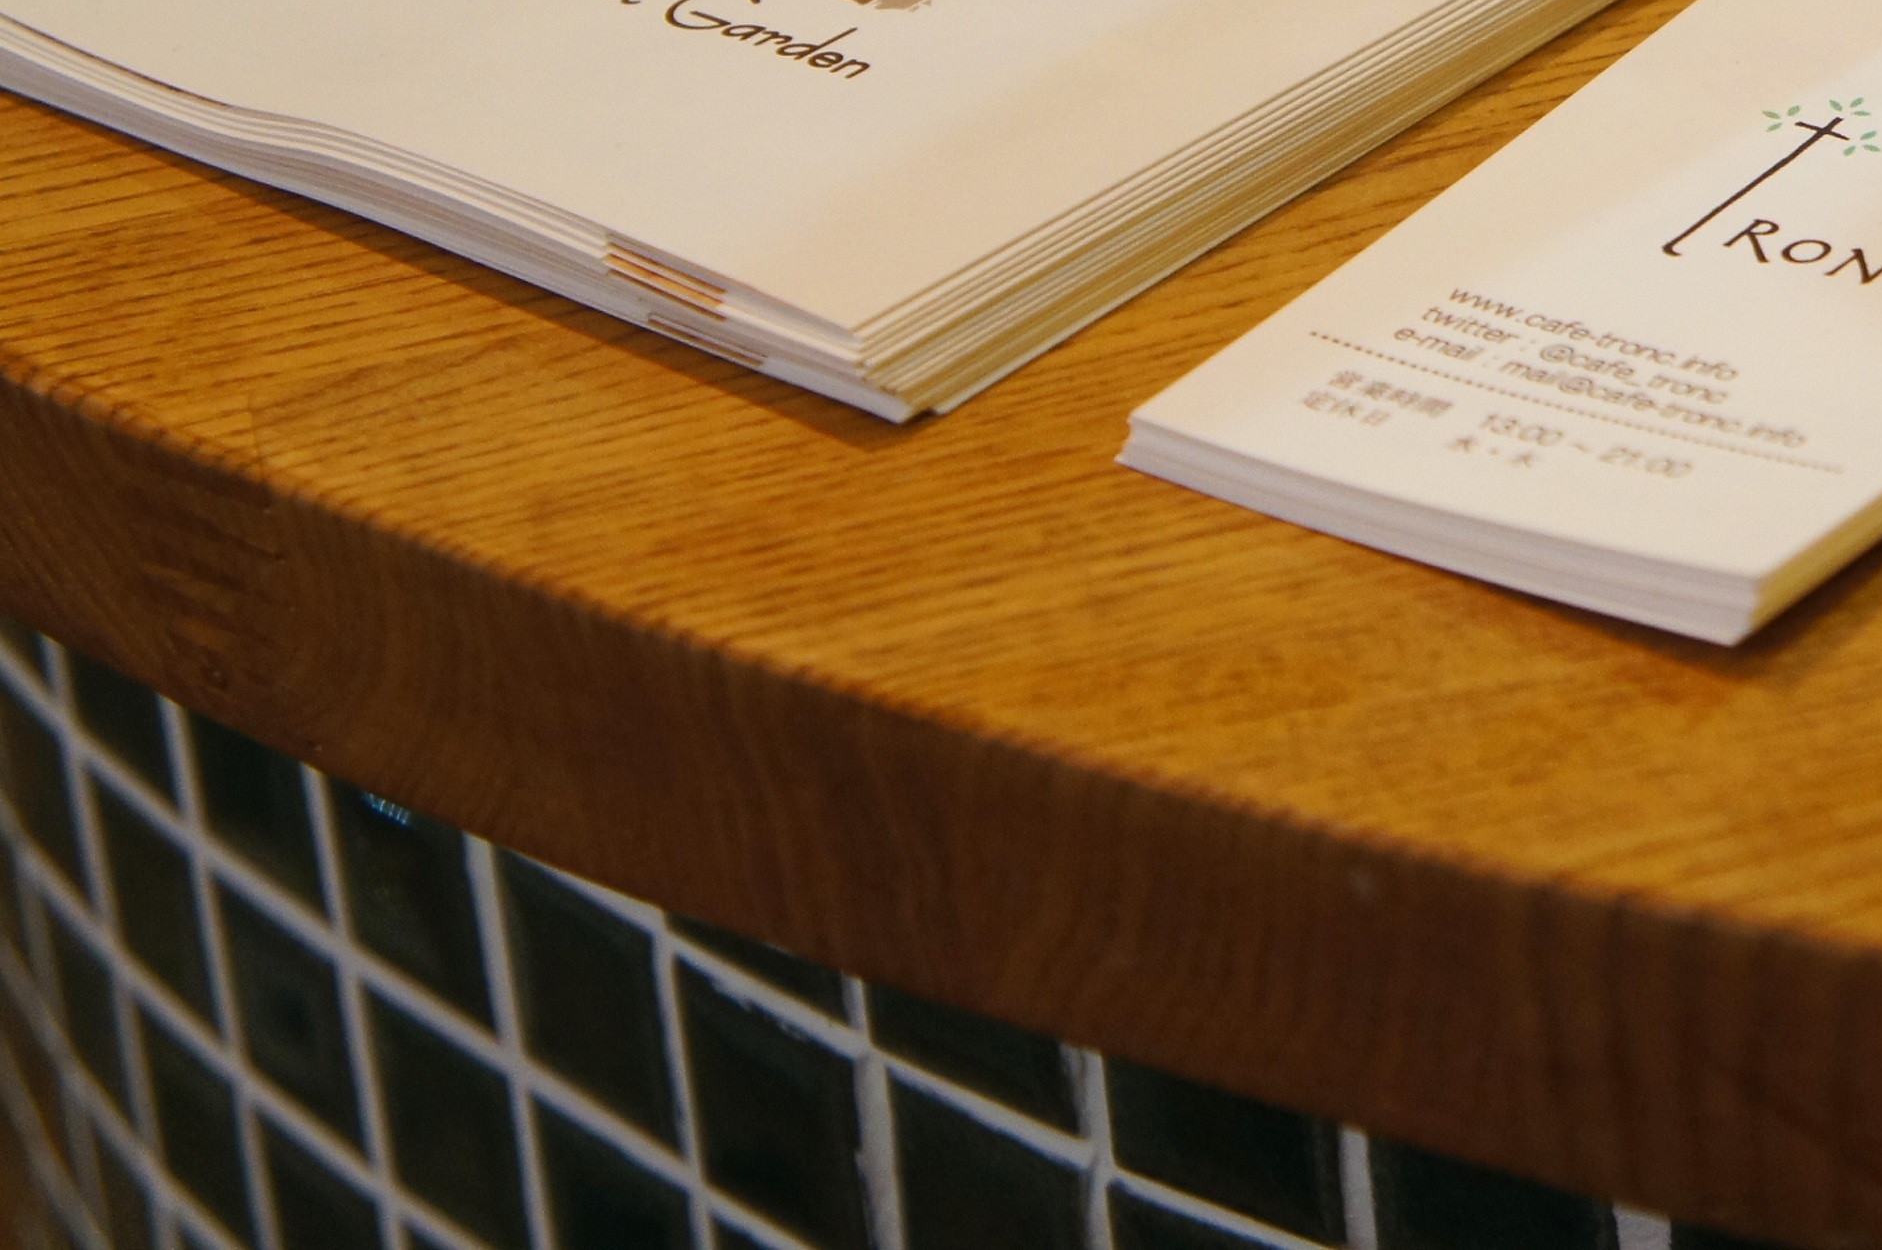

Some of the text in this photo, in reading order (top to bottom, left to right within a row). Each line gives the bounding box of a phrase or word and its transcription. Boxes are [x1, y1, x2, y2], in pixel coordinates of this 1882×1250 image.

[1393, 326, 1486, 362] e-mail
[1421, 305, 1519, 345] twitter
[1449, 287, 1740, 382] www.cafe-tronc.info
